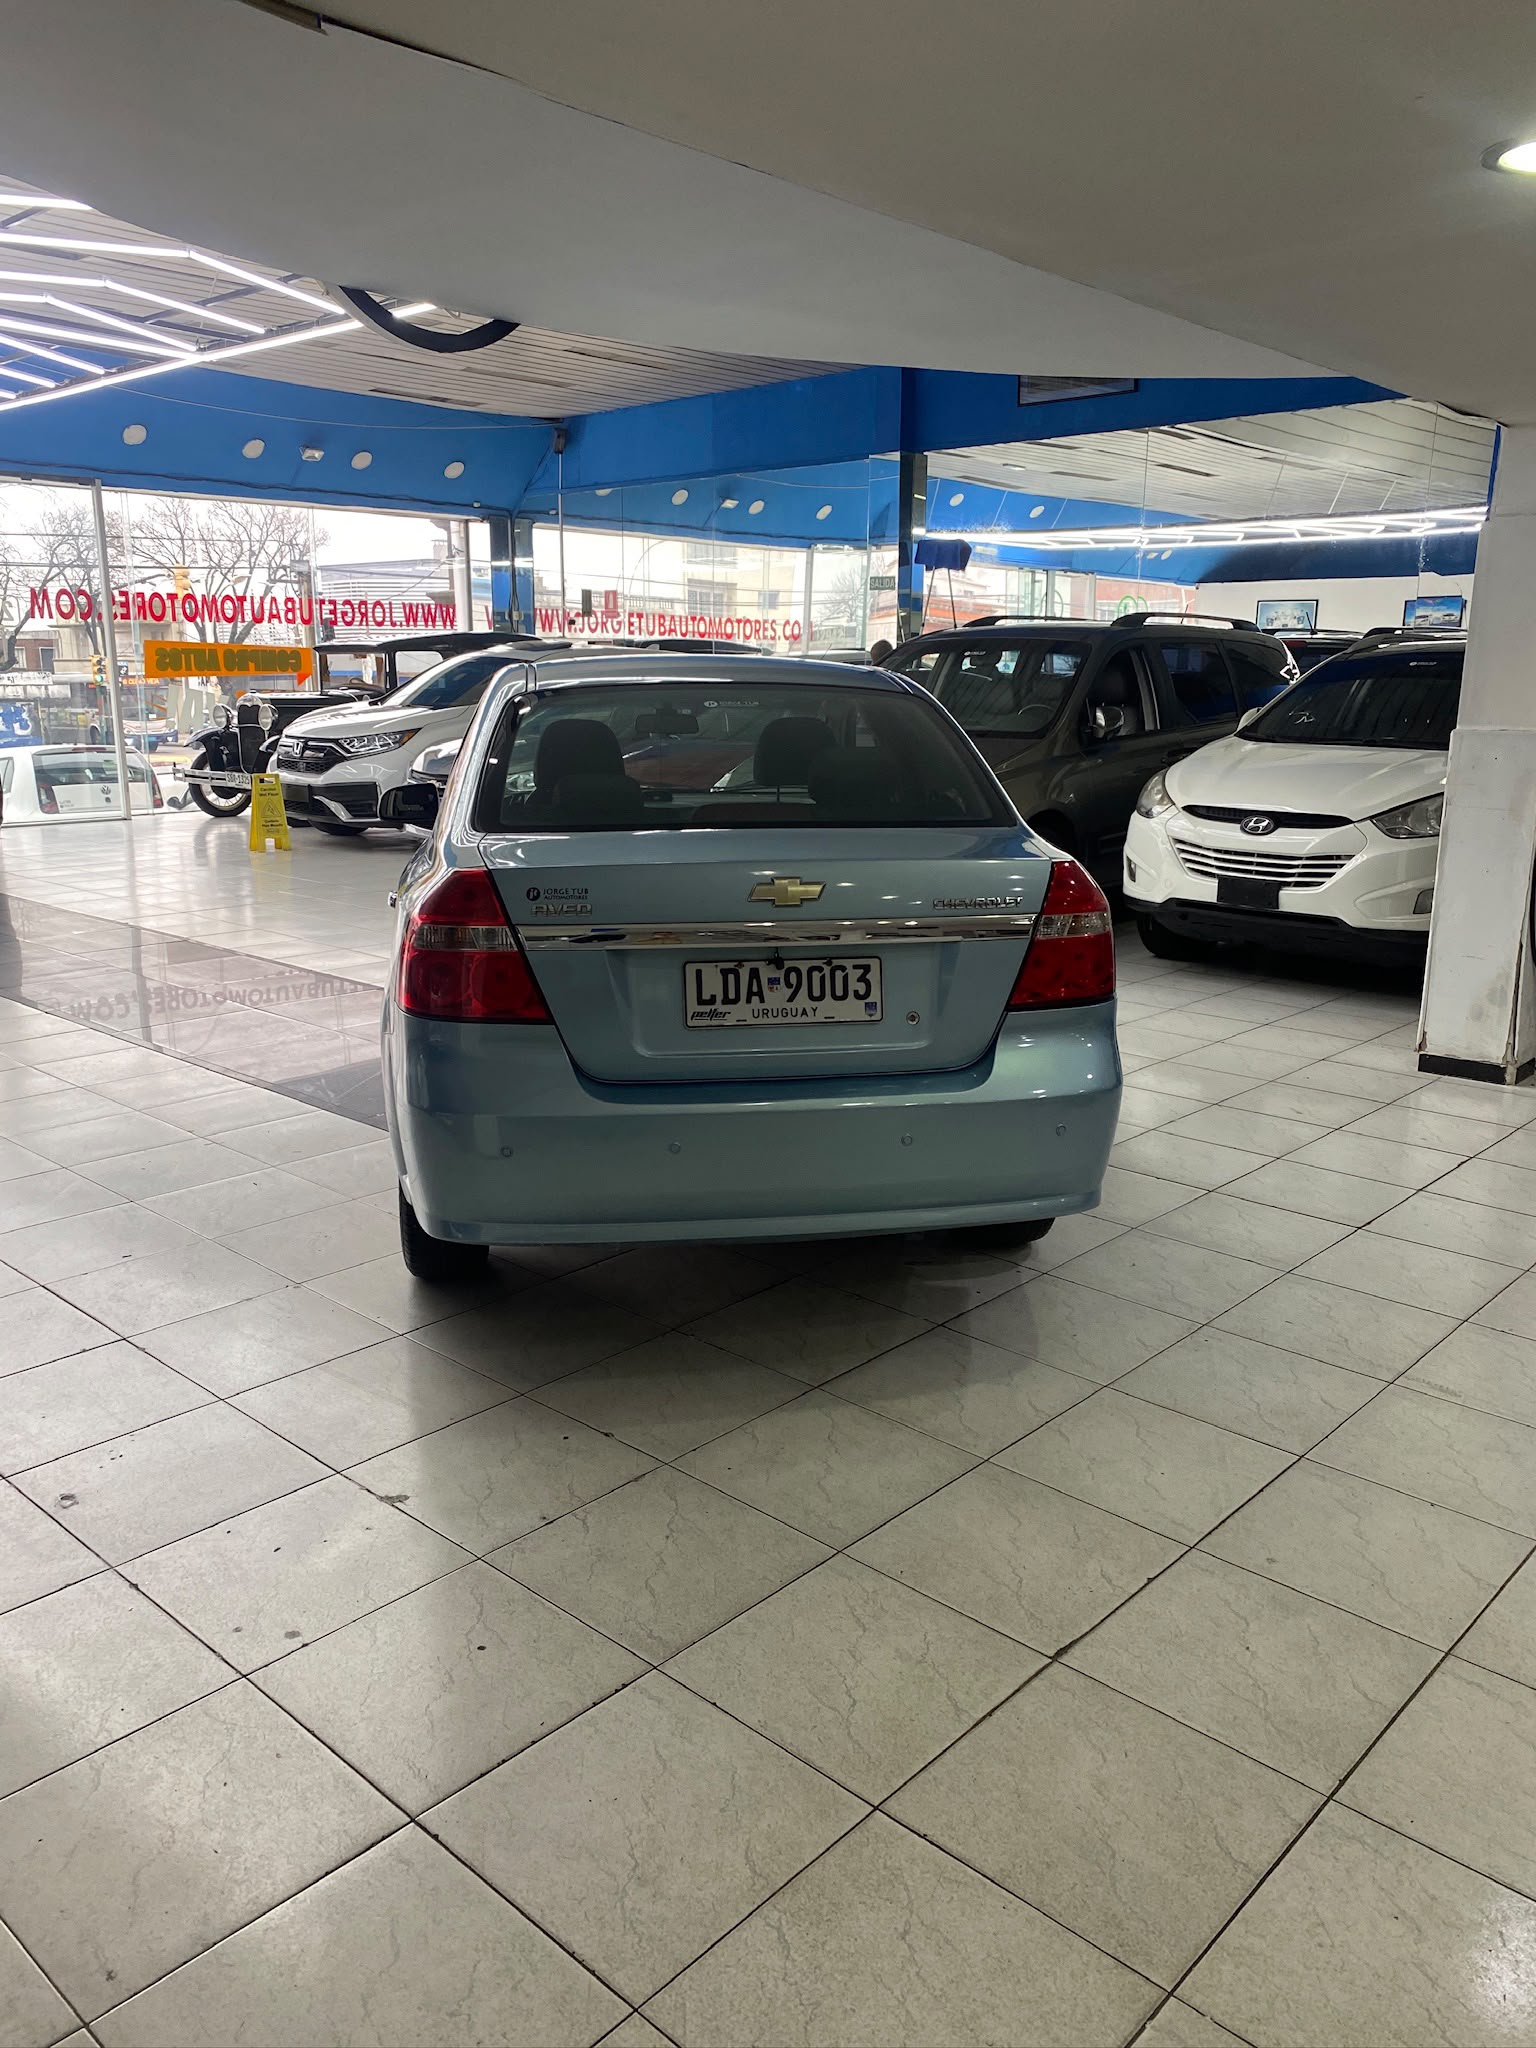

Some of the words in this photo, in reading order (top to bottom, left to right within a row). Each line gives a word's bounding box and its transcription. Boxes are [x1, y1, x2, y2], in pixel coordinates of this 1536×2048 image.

[870, 579, 895, 588] SALIDA
[532, 903, 592, 917] AVEO
[933, 897, 1023, 910] CHEVROLET
[695, 967, 765, 1006] LDA
[784, 964, 872, 1003] 9003
[752, 1007, 818, 1019] URUGUAY
